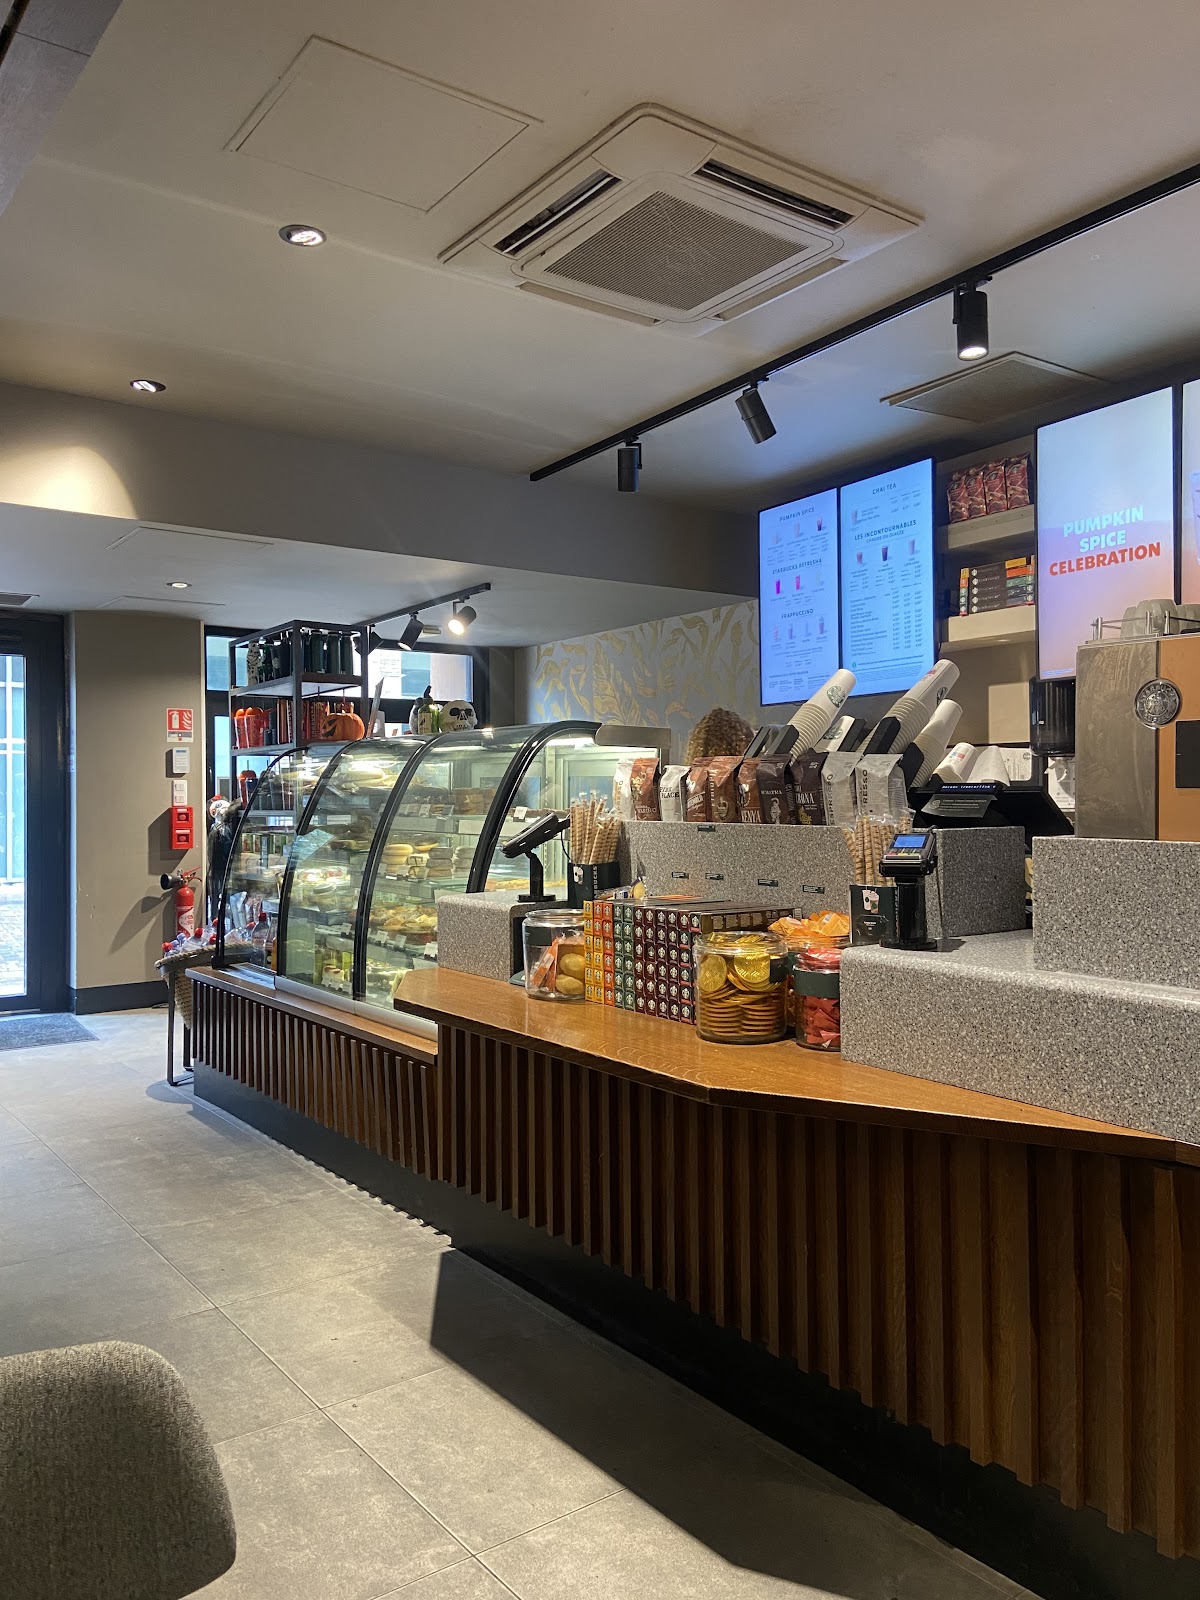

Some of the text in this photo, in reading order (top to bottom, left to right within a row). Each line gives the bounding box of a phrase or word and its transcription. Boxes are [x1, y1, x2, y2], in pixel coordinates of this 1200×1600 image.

[872, 483, 897, 495] CHAI TEA
[779, 507, 815, 522] PUMPKIN SPICE
[1063, 505, 1144, 537] PUMPKIN
[854, 519, 917, 541] LES INCONTOURNABLES
[1079, 529, 1126, 553] SPICE
[1049, 541, 1161, 576] CELEBRATION
[772, 563, 798, 575] STARBUCKS
[781, 608, 814, 619] FRAPPUCCINO
